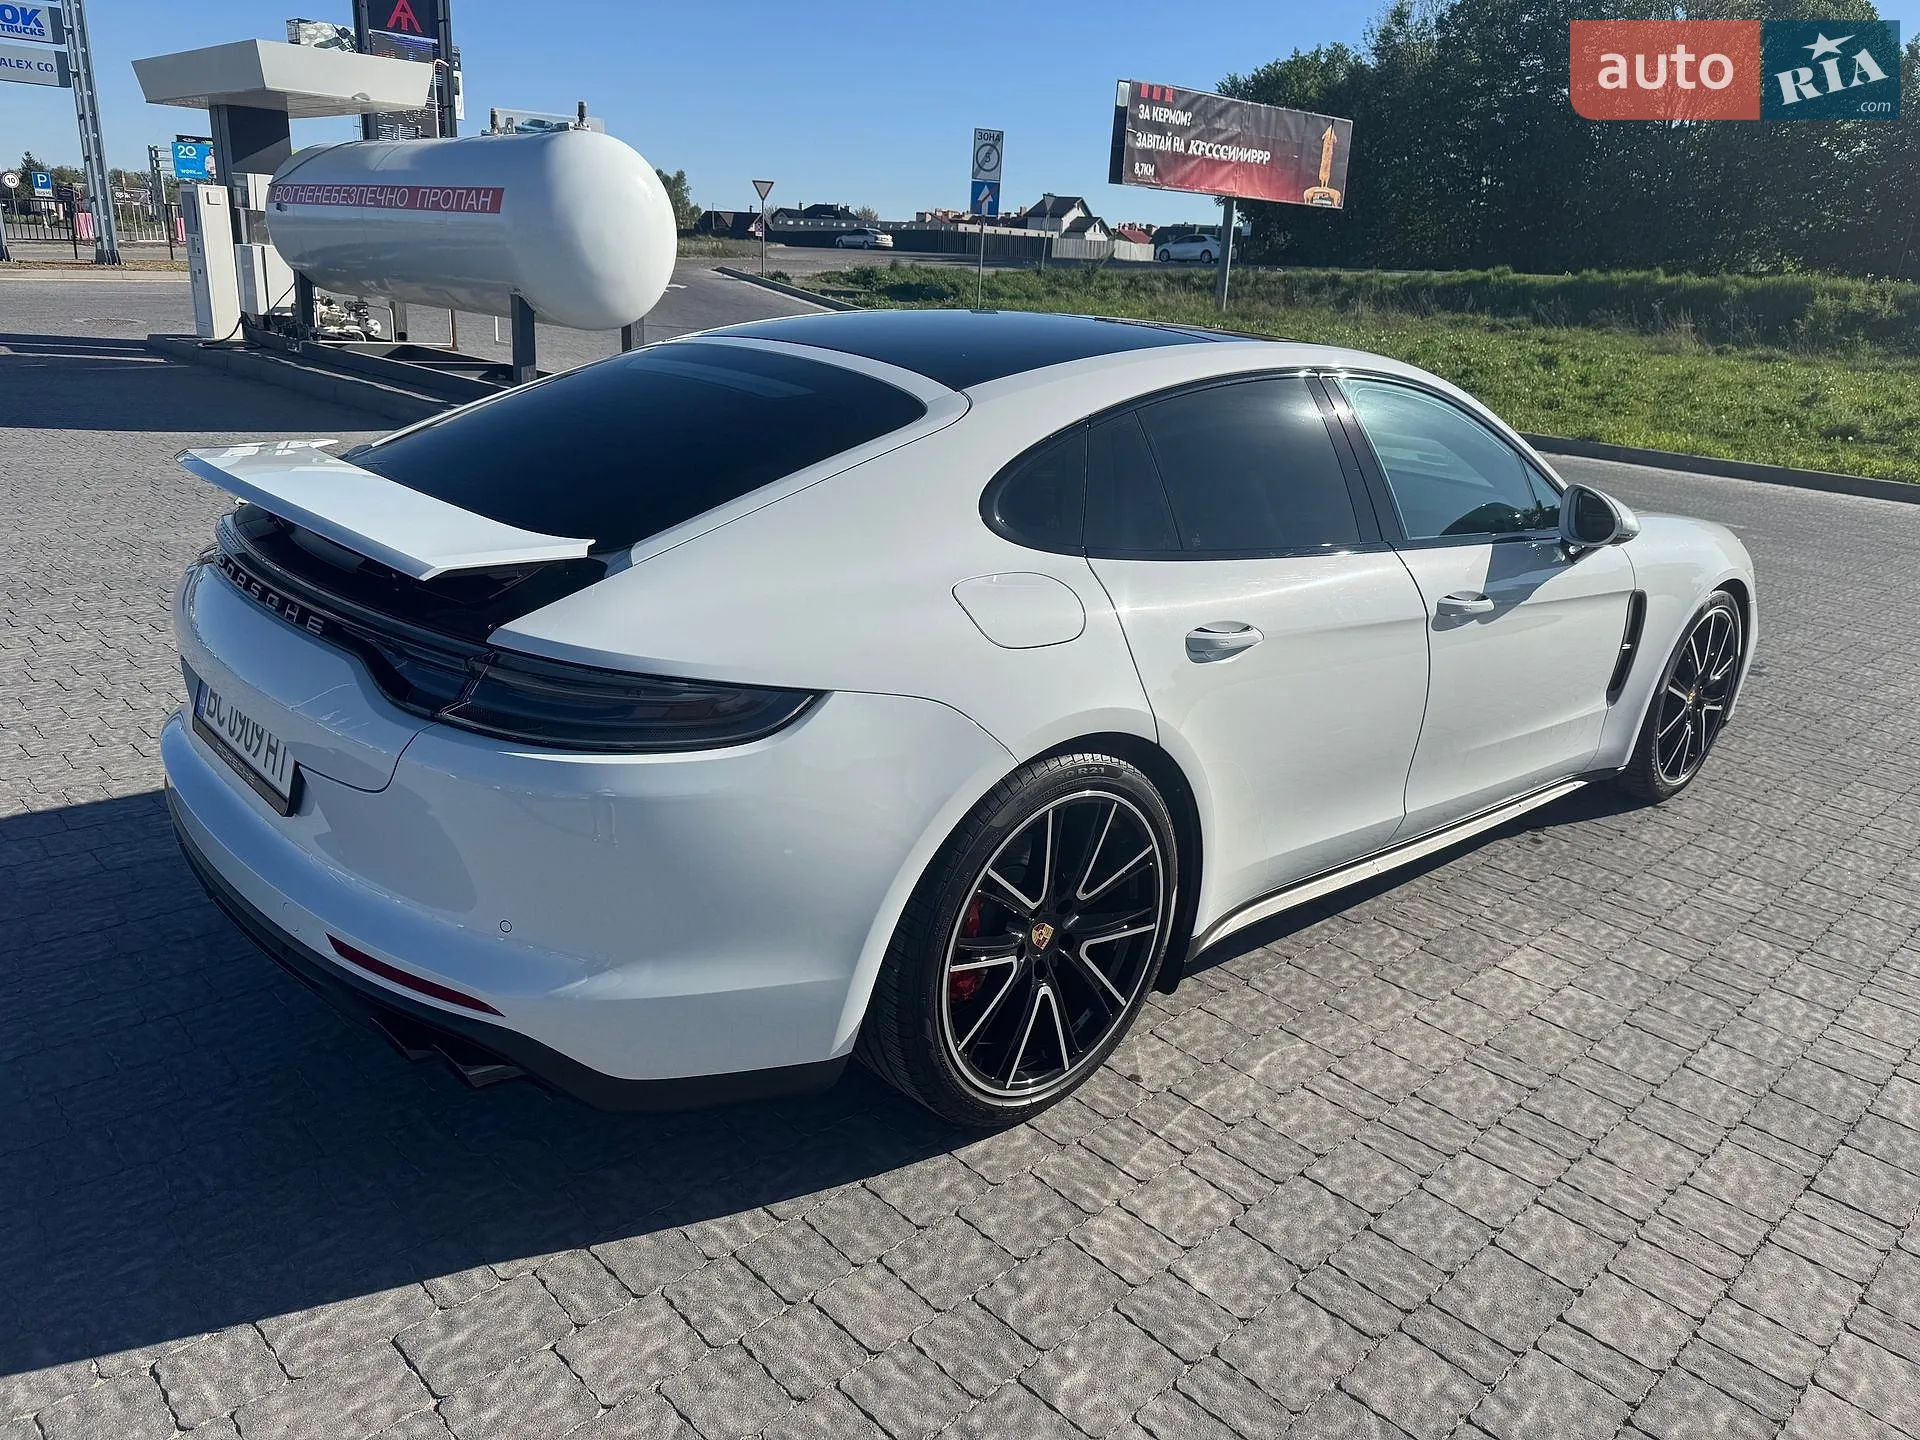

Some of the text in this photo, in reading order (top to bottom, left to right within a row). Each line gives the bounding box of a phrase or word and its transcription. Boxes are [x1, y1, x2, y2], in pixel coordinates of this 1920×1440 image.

[0, 23, 45, 37] TRUCKS
[0, 57, 57, 73] ALEX CO.
[1138, 103, 1193, 127] ЗА КЕРМОМ?
[977, 131, 1001, 142] ЗОНА
[1135, 131, 1172, 151] ЗАВІТАЙ
[1173, 137, 1185, 154] НА
[177, 145, 197, 156] 20
[274, 185, 493, 211] ВОГНЕНЕБЕЗПЕЧНО ПРОПАН
